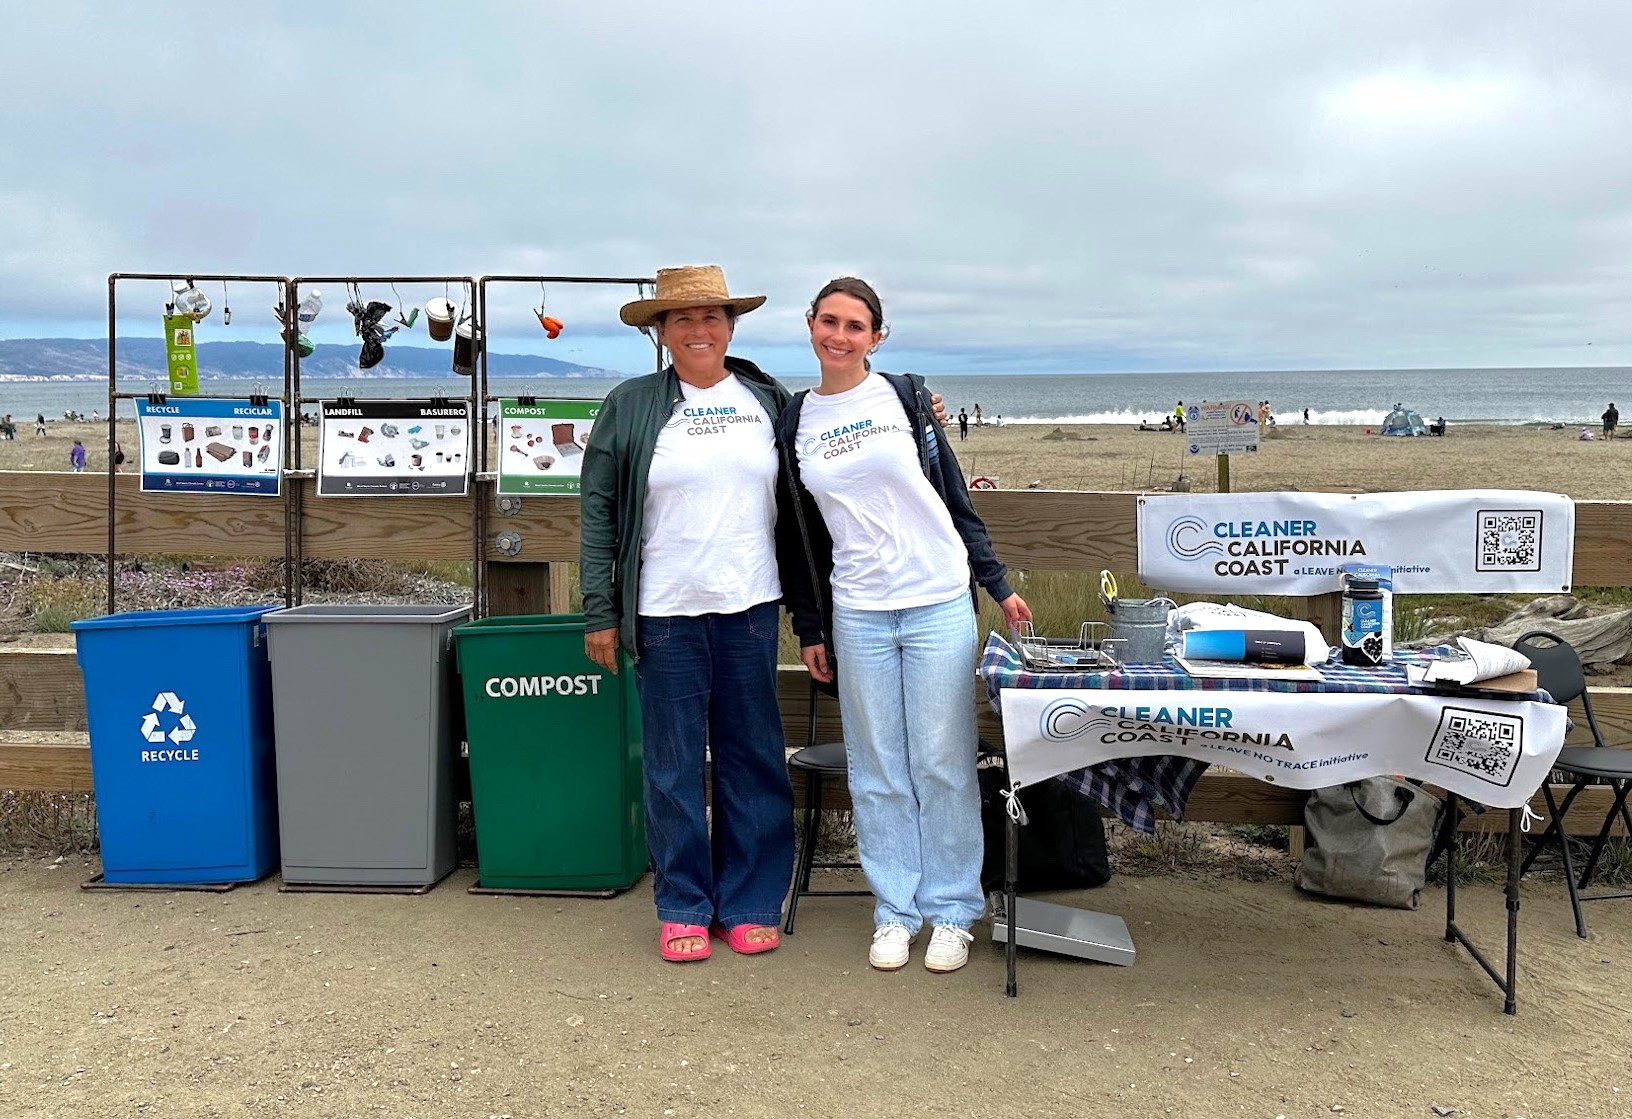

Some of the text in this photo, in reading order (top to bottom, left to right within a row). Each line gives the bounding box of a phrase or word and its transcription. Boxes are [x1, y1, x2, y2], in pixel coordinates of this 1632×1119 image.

[146, 406, 180, 414] RECYCLE
[233, 407, 272, 416] RECICLAR
[324, 408, 363, 416] LANDFILL
[420, 408, 466, 416] BASURERO
[504, 407, 546, 415] COMPOST
[683, 406, 737, 417] CLEANER
[692, 415, 762, 425] CALIFORNIA
[687, 425, 727, 436] COAST
[820, 419, 873, 442] CLEANER
[828, 424, 900, 448] CALIFORNIA
[823, 440, 862, 460] COAST
[1213, 520, 1317, 538] CLEANER
[1228, 540, 1367, 556] CALIFORNIA
[1214, 559, 1289, 576] COAST
[1302, 567, 1334, 576] LEAVE
[1388, 565, 1431, 573] nitiative
[485, 675, 602, 698] COMPOST
[1100, 706, 1233, 728] CLEANER
[1117, 720, 1294, 751] CALIFORNIA
[141, 749, 199, 762] RECYCLE
[1100, 731, 1195, 745] COAST
[1210, 744, 1251, 756] LEAVE
[1253, 752, 1274, 763] NO
[1275, 758, 1318, 770] TRACE
[1319, 752, 1369, 767] initiative
